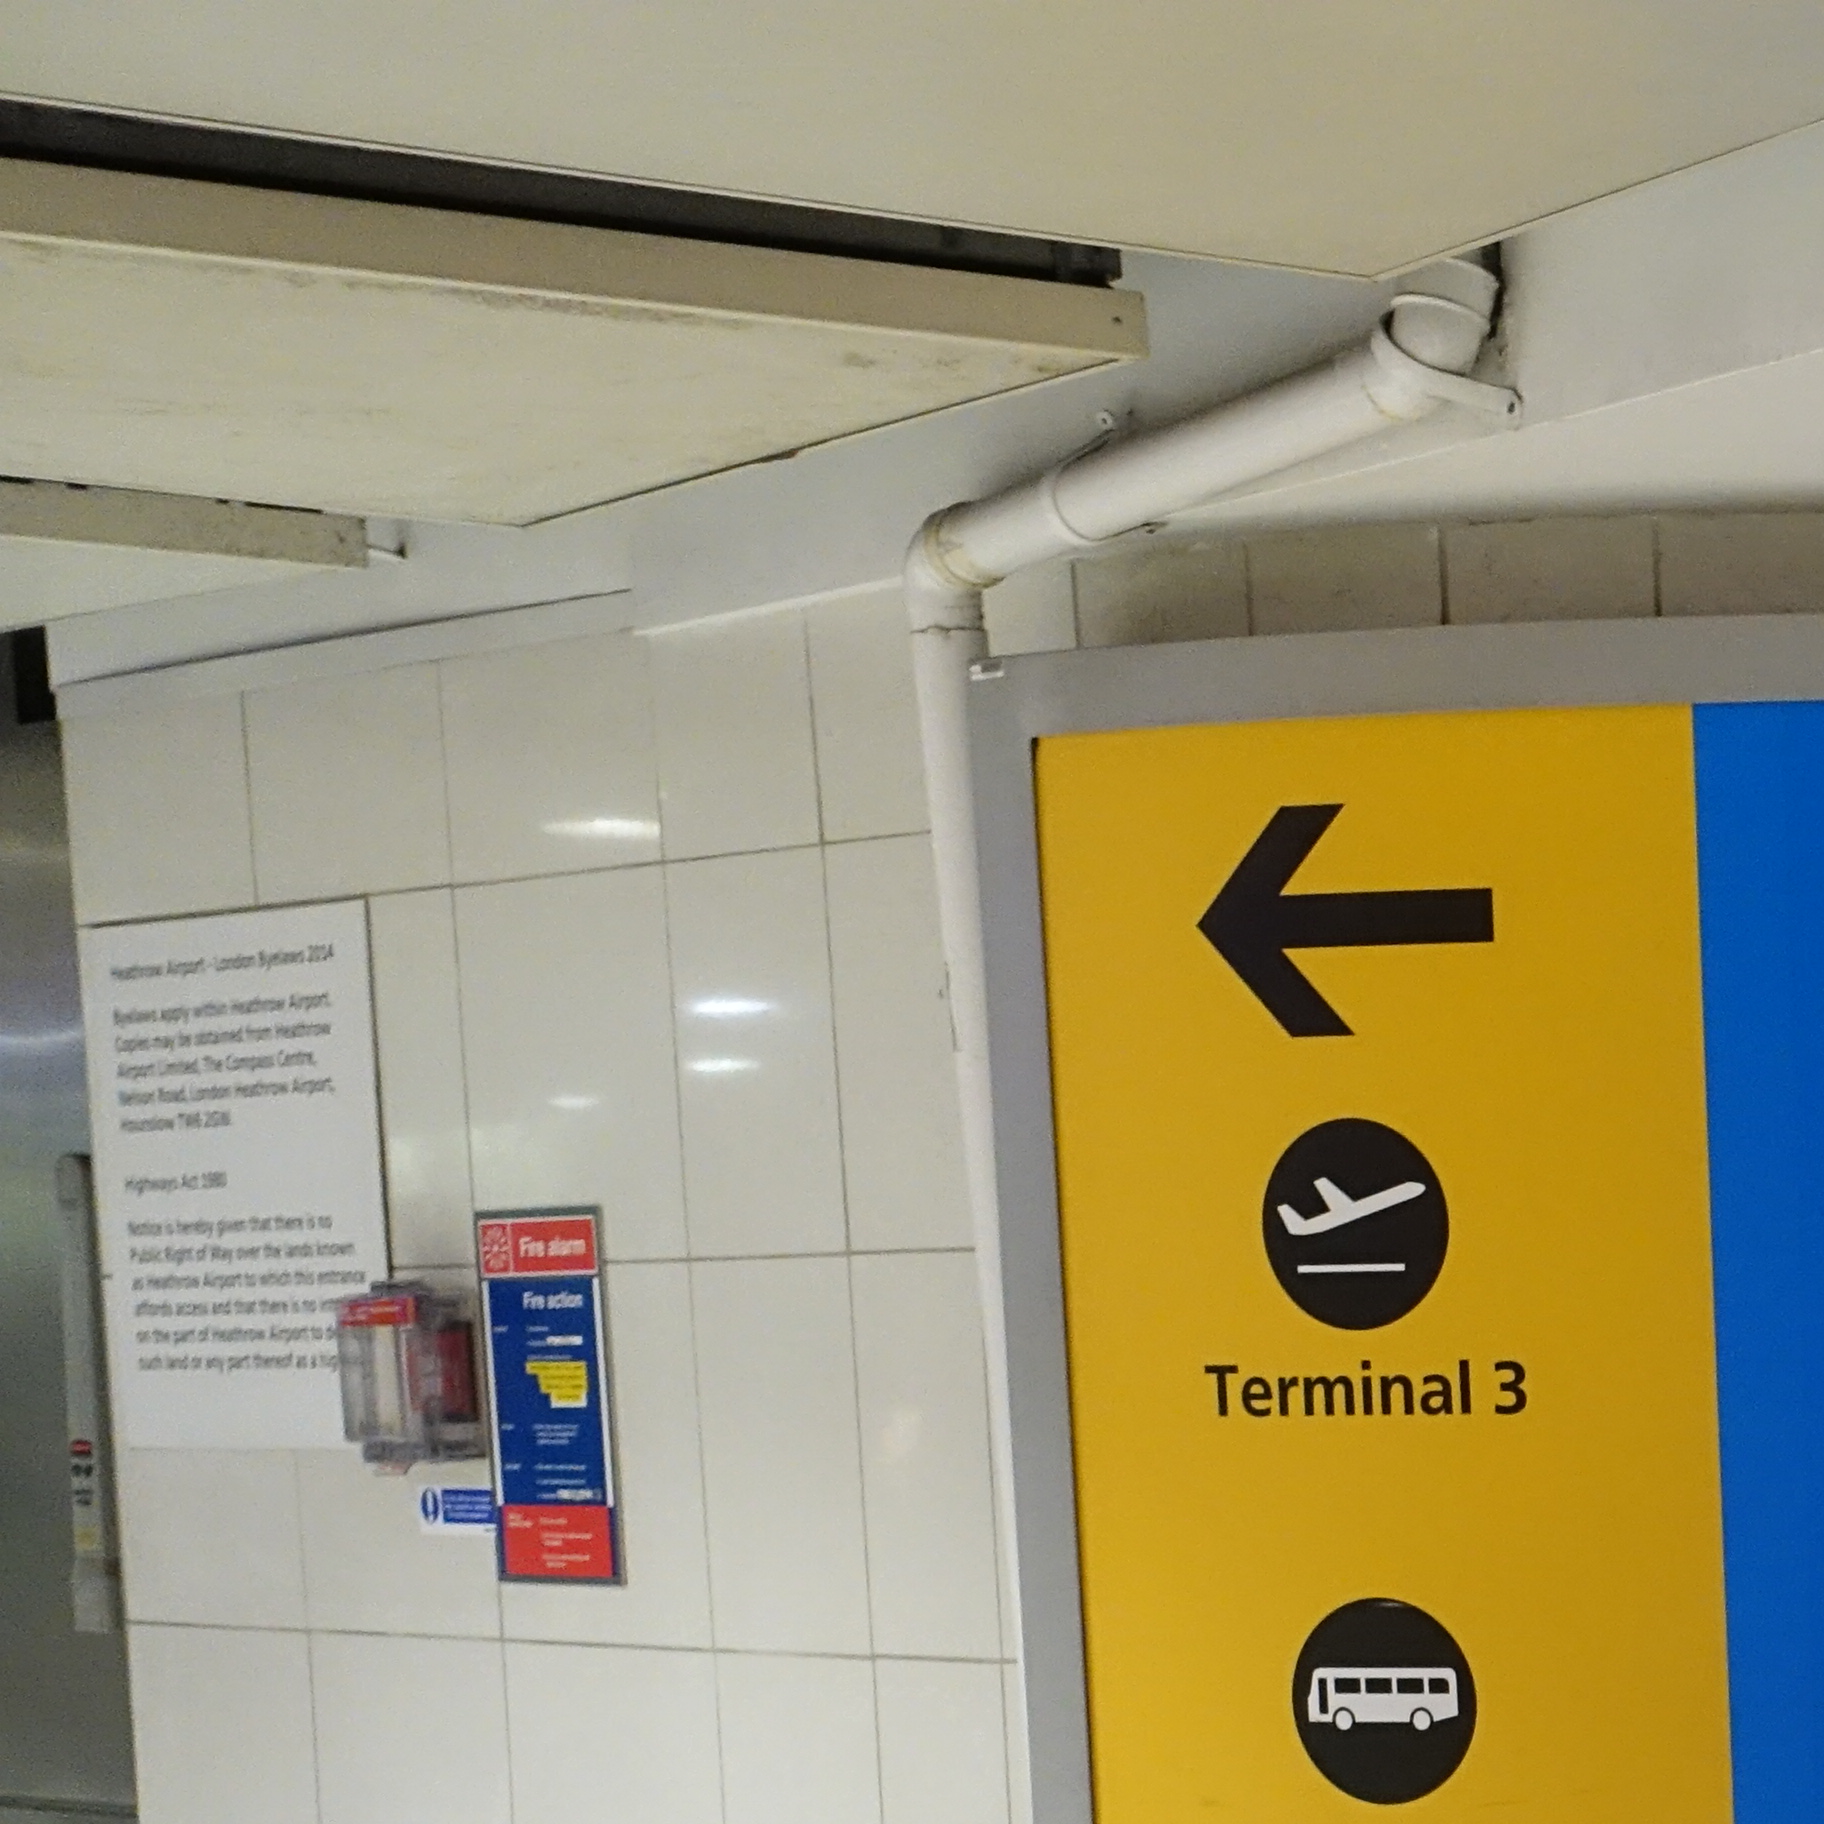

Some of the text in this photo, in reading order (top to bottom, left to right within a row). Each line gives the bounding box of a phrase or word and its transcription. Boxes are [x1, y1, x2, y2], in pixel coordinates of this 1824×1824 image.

[520, 1236, 545, 1258] Fire
[522, 1291, 583, 1310] Fire action
[1205, 1360, 1526, 1417] Terminal 3
